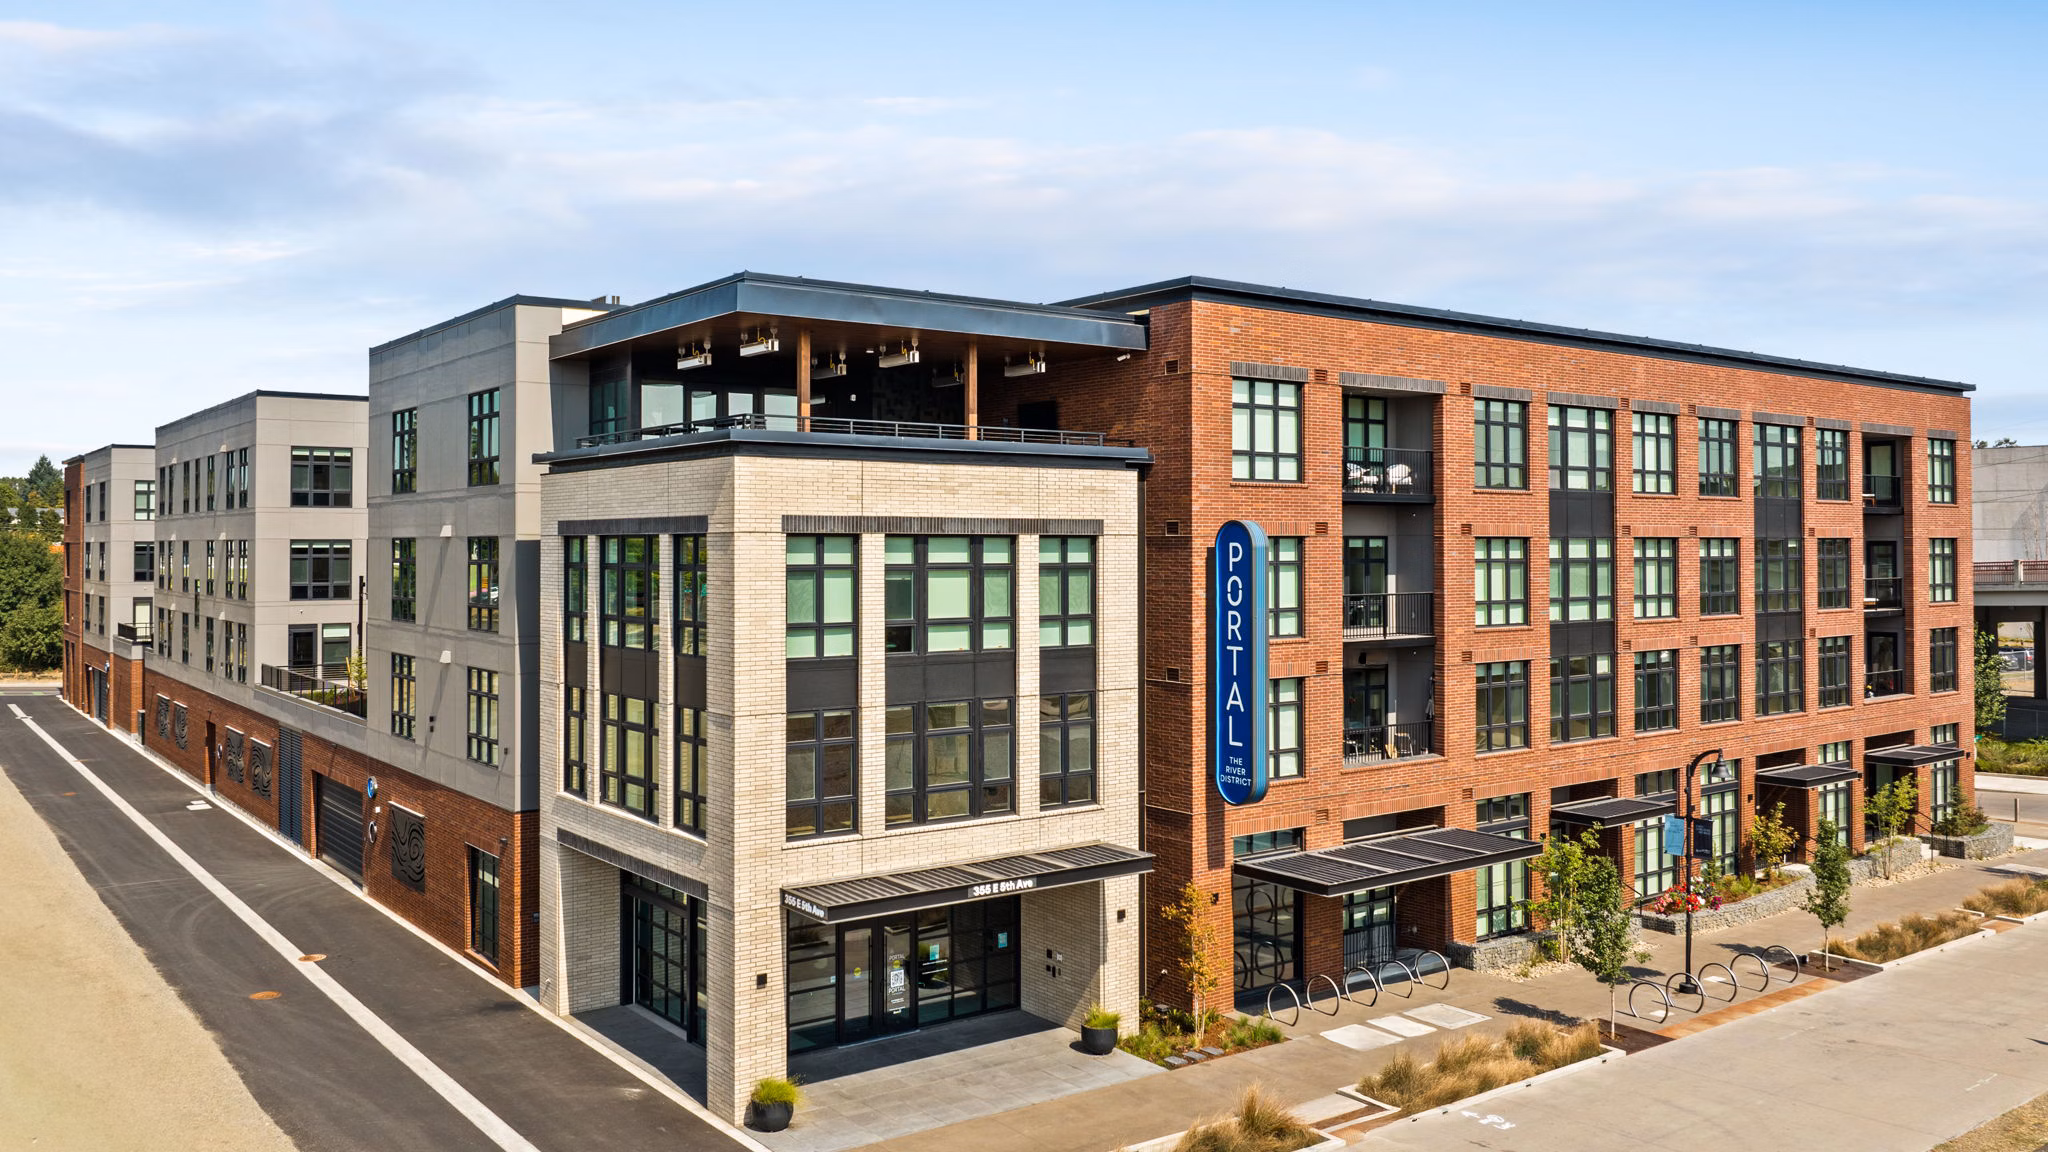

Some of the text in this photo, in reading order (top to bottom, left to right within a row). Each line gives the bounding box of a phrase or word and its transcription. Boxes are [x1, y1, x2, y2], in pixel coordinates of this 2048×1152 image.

[1226, 541, 1245, 748] PORTAL
[1229, 756, 1243, 766] THE
[1225, 765, 1246, 776] RIVER
[1220, 774, 1252, 787] DISTRICT
[972, 878, 1034, 897] 355 E 5th Ave
[784, 893, 825, 918] 355 E 5th Ave
[888, 986, 906, 994] PORTAL
